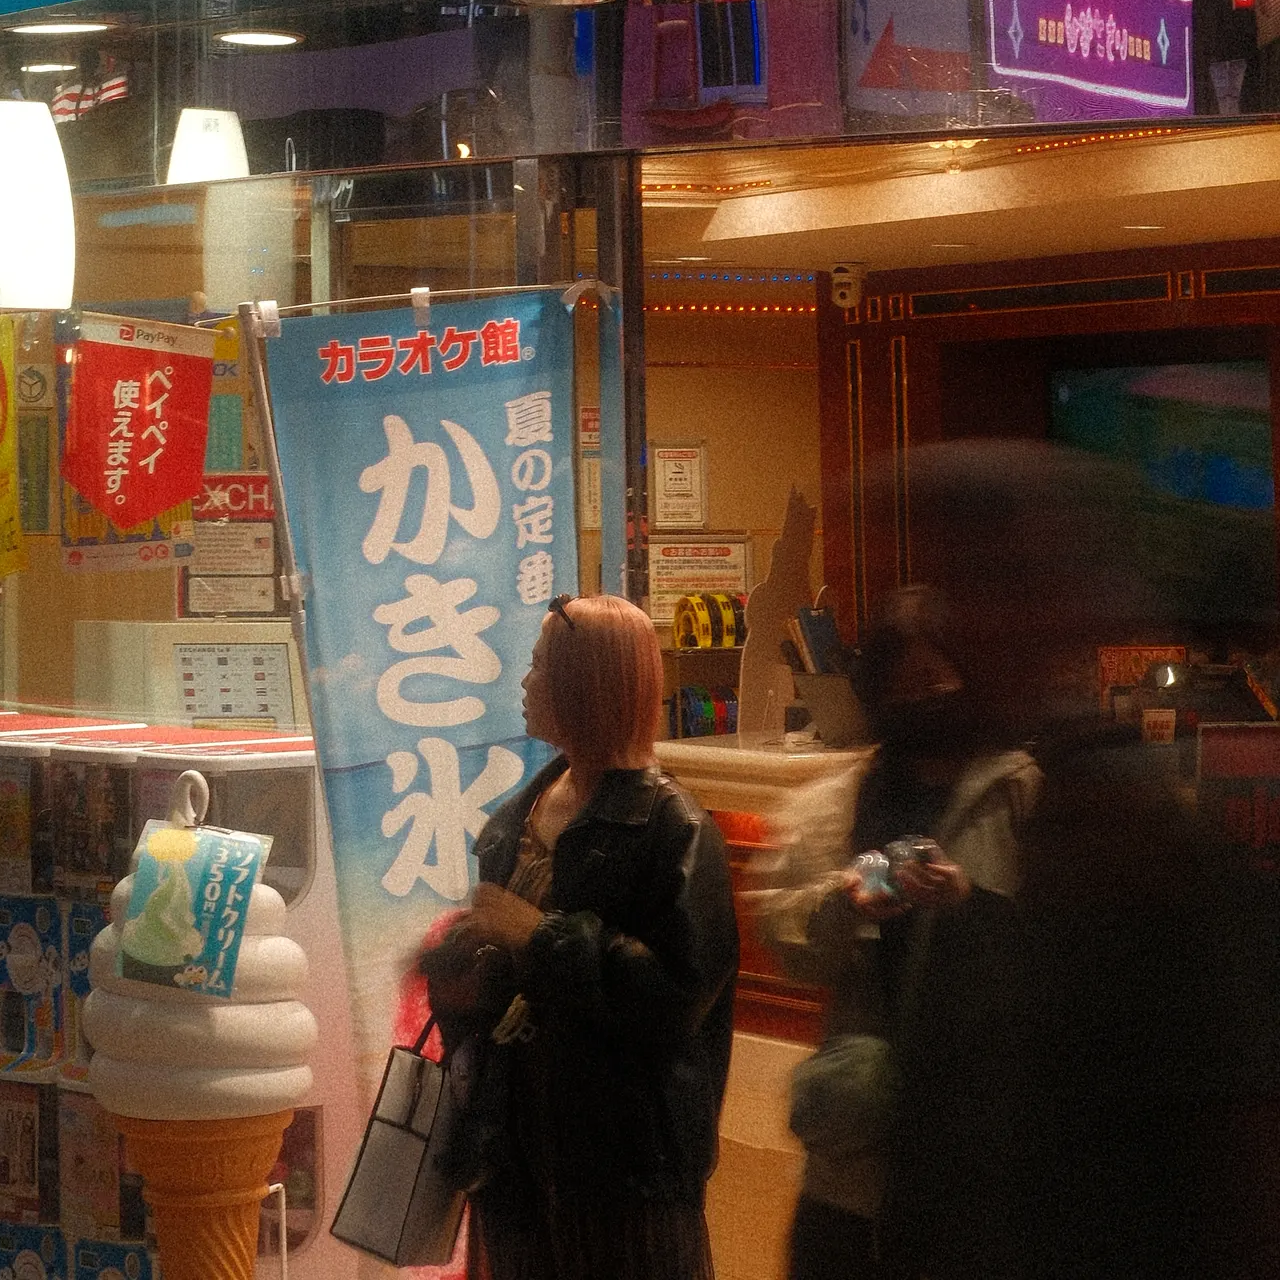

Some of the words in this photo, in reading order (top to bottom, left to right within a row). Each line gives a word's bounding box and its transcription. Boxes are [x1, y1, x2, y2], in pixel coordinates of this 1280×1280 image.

[136, 328, 178, 347] PayPay
[317, 317, 522, 386] カラオケ館
[103, 378, 142, 506] 使えます。
[138, 365, 175, 475] ペイペイ
[504, 390, 555, 606] 夏の定番
[357, 414, 526, 902] かき氷
[206, 850, 255, 991] ソフトクリーム
